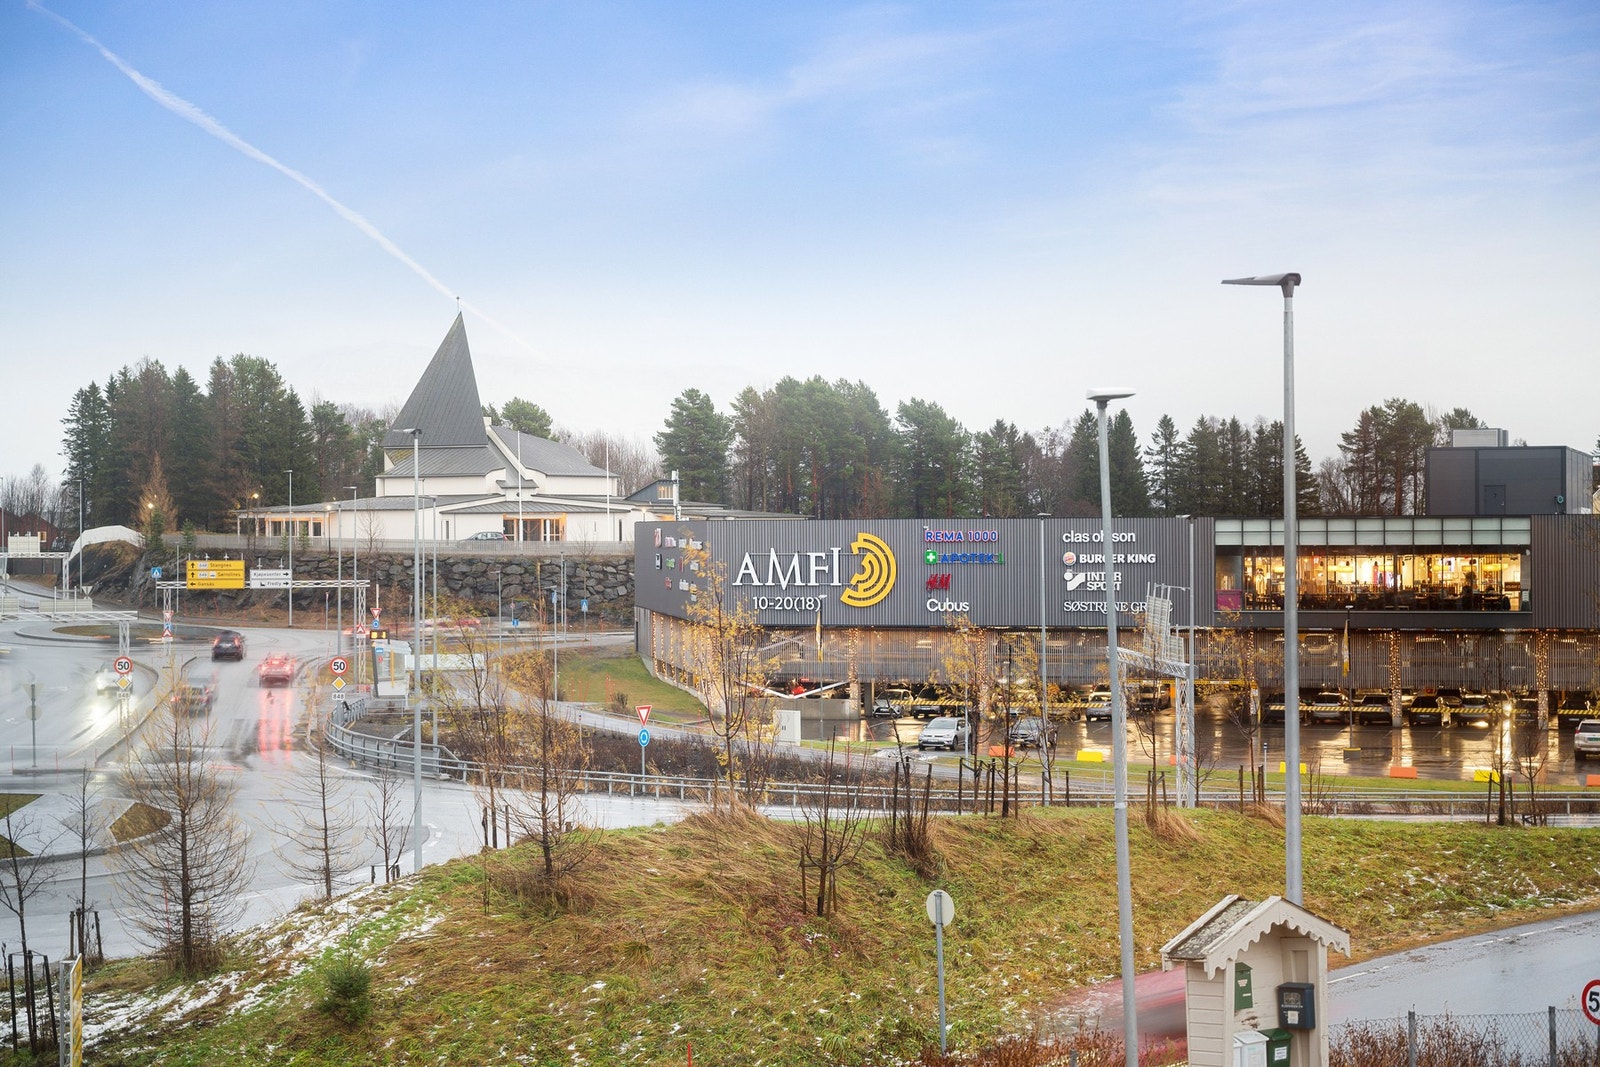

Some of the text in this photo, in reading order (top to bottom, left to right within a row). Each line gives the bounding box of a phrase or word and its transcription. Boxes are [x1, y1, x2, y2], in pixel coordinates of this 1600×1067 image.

[925, 530, 998, 542] REMA 1000
[1062, 529, 1136, 543] clas oson
[940, 551, 1004, 565] APOTEK 1
[1079, 553, 1156, 564] BURER KING
[732, 547, 842, 590] AMFI
[1087, 571, 1122, 581] INTR
[1087, 581, 1122, 591] SPOT
[753, 596, 821, 612] 10-20(18)
[926, 597, 970, 612] Cubus
[117, 661, 130, 671] 50
[333, 661, 346, 671] 50
[1588, 990, 1600, 1013] 5
